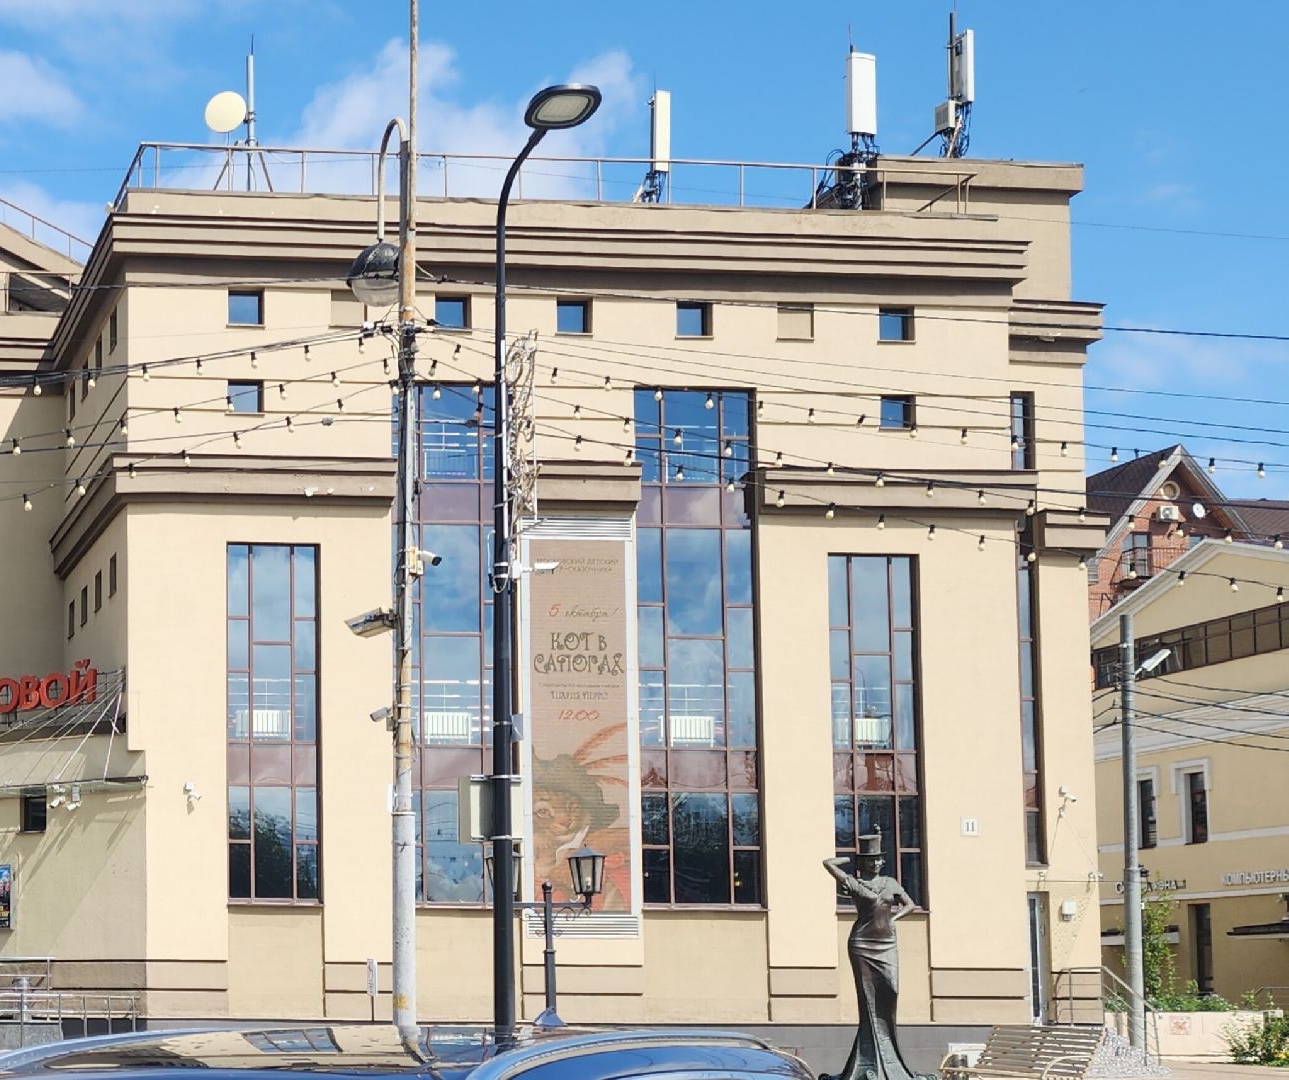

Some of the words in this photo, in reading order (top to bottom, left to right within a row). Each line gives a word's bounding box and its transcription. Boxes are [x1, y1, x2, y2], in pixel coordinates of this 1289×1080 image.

[548, 603, 561, 617] 5
[550, 632, 594, 651] КОТ
[598, 635, 607, 651] В
[533, 653, 625, 676] САПОГАХ
[965, 821, 975, 832] 11
